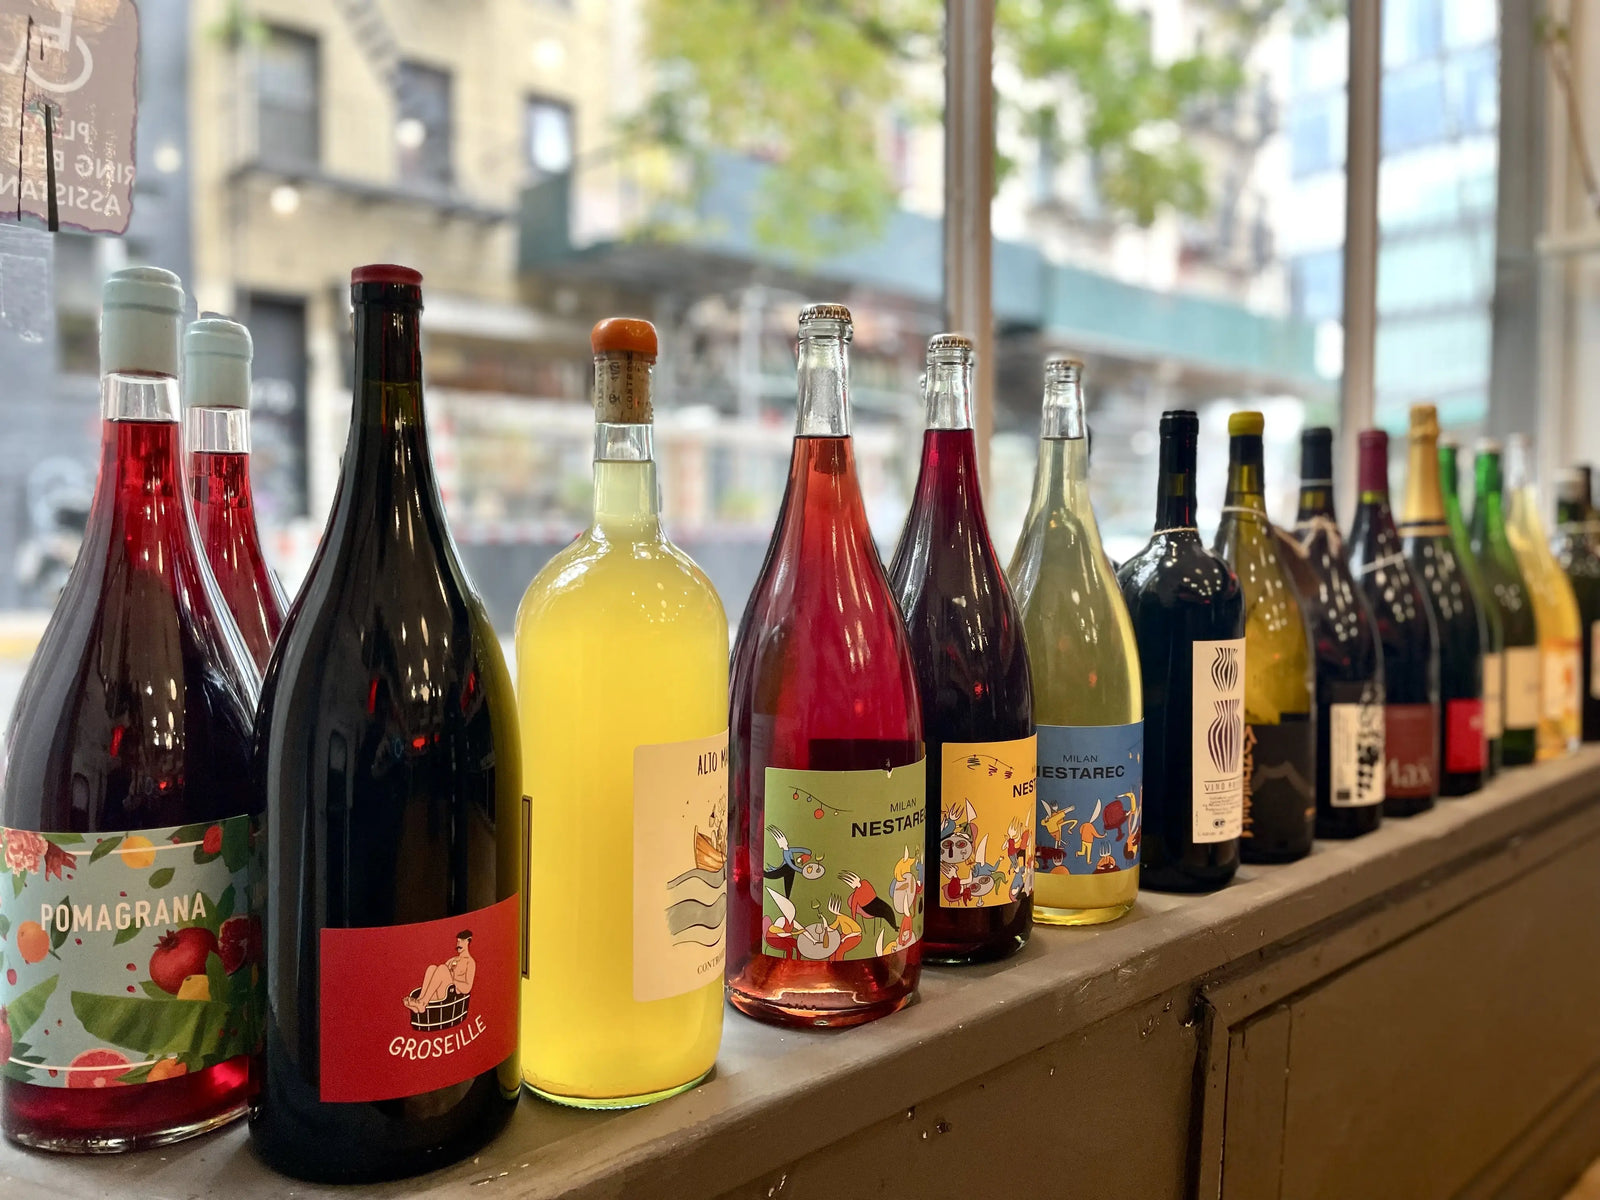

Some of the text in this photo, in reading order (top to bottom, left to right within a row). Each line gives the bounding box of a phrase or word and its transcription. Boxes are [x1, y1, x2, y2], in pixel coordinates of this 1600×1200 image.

[697, 751, 718, 776] ALTO
[1062, 754, 1099, 764] MILAN
[889, 798, 917, 813] MILAN
[851, 807, 926, 838] NESTARE
[40, 892, 207, 933] POMAGRANA
[388, 1014, 487, 1060] GROSEILLE
